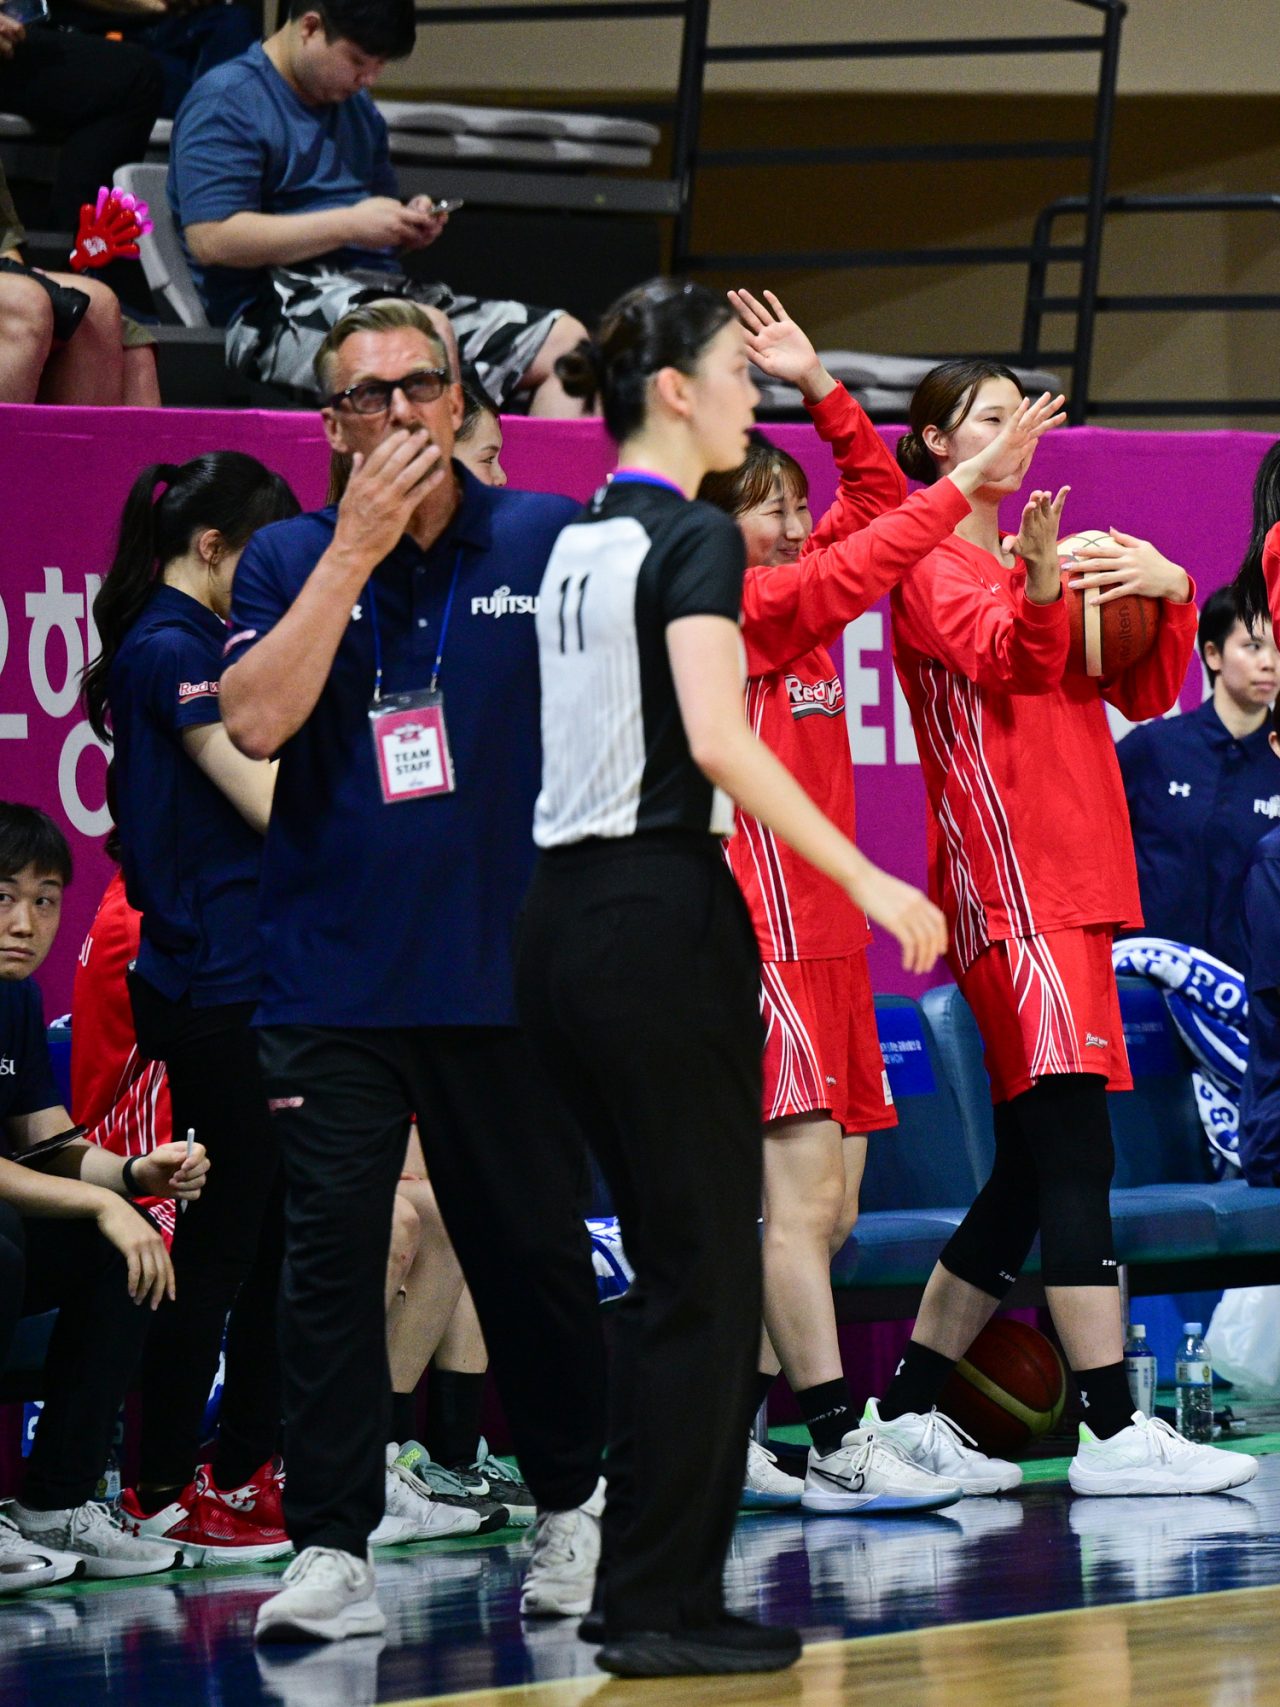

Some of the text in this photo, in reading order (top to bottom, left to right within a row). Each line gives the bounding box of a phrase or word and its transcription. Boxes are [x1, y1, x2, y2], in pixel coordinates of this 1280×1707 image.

[560, 573, 589, 654] 11
[785, 674, 826, 704] Red
[394, 748, 431, 763] TEAM
[395, 760, 432, 775] STAFF
